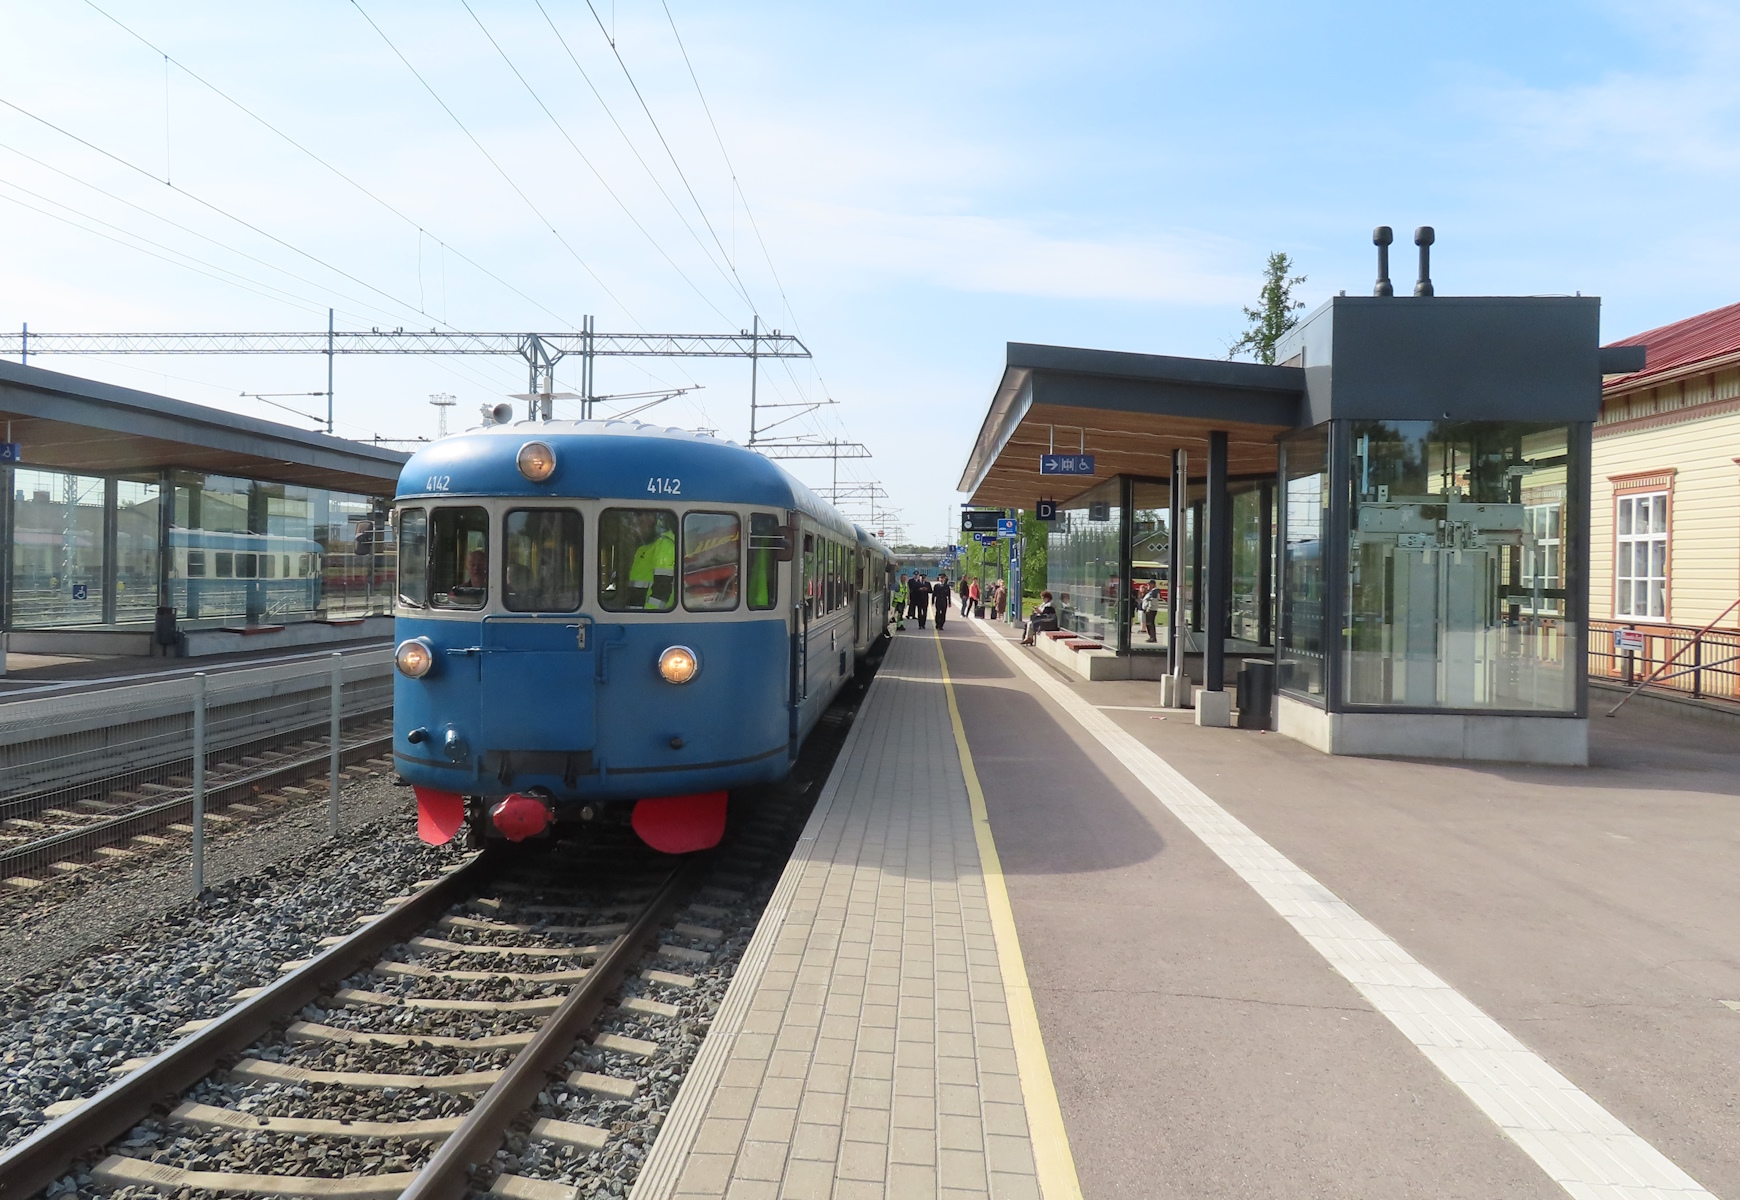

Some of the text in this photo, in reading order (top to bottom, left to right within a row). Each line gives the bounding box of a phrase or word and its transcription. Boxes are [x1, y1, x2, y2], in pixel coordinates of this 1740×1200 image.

[426, 475, 450, 491] 4142
[647, 477, 681, 495] 4142
[1041, 504, 1052, 517] D
